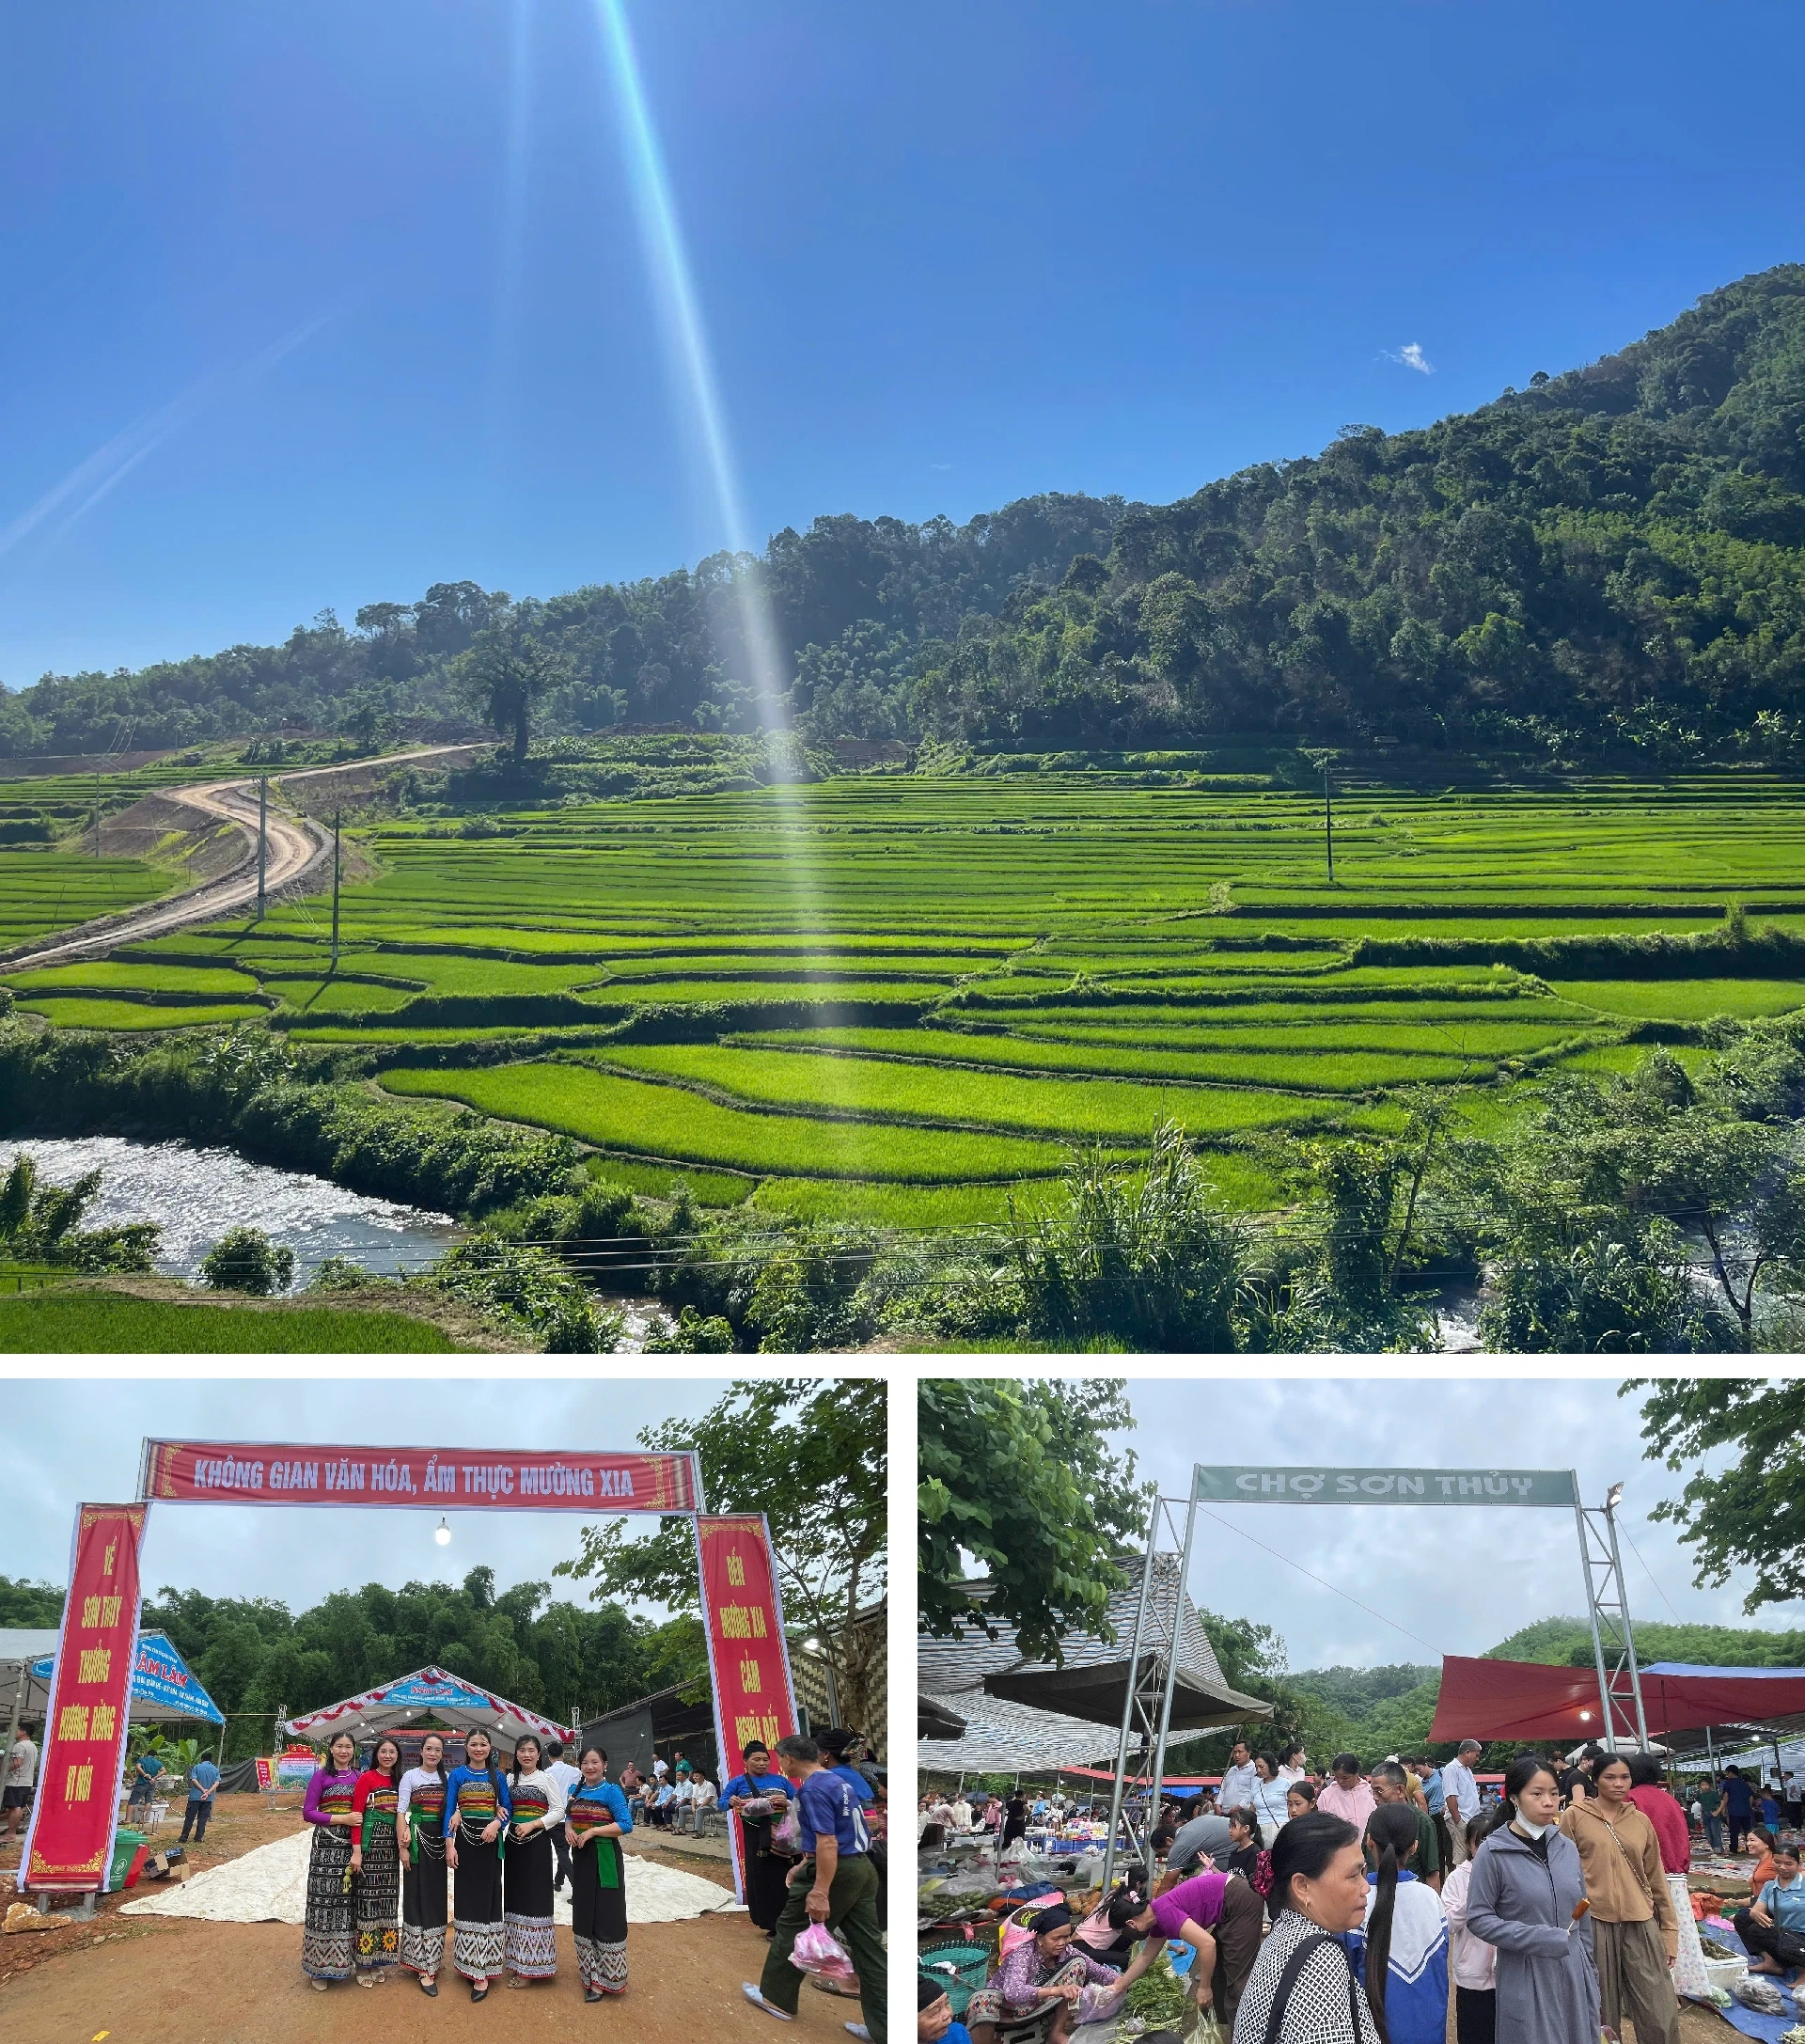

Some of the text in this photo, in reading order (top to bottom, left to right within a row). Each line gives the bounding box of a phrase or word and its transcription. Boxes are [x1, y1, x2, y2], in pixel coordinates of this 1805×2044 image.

[194, 1454, 635, 1501] KHÔNG GIAN VĂN HÓA, ẨM THỰC MƯỜNG XIA
[1235, 1470, 1533, 1500] CHỢ SƠN THỦY
[81, 1584, 123, 1628] SƠN THỦY
[719, 1598, 768, 1639] MƯỜNG XIA
[77, 1638, 112, 1684] THƯỞNG
[740, 1648, 761, 1694] CẢM
[57, 1698, 117, 1741] HƯƠNG RỪNG
[64, 1756, 94, 1811] VỊ NÚI
